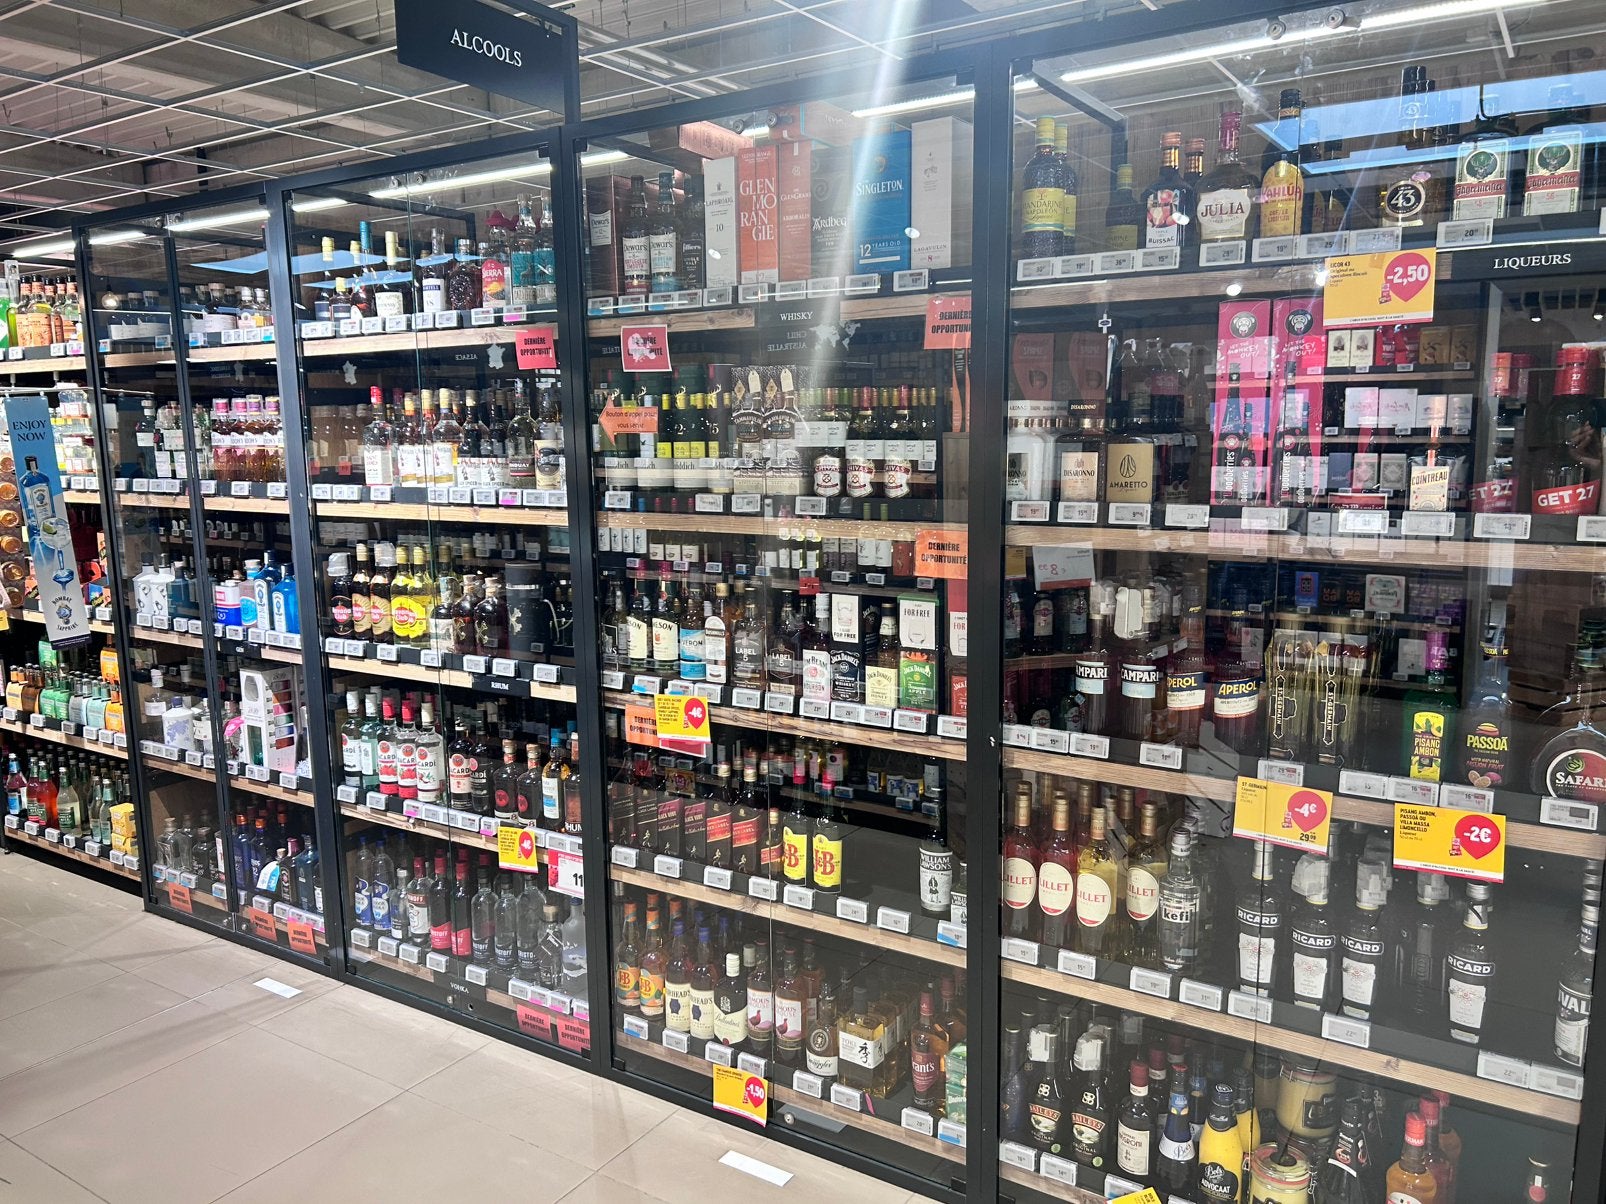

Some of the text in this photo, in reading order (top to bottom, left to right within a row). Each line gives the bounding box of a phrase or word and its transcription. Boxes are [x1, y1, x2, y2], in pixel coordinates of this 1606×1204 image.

[450, 28, 522, 69] ALCOOLS
[740, 178, 775, 195] GLEN
[753, 193, 777, 210] MO
[1391, 188, 1415, 208] 43
[1201, 201, 1244, 218] JULIA
[741, 210, 768, 227] RAN
[752, 225, 774, 241] GIE
[1148, 236, 1174, 246] BUISSAC
[859, 240, 901, 257] 12 YEARS OLD
[1494, 254, 1571, 269] LIQUEURS
[1387, 264, 1429, 285] -2,50
[780, 311, 814, 321] WHISKY
[931, 323, 971, 334] OPPORTUNI
[1227, 344, 1258, 354] MONKEY
[1282, 342, 1315, 352] MONKEY
[12, 419, 48, 431] ENJOY
[17, 431, 46, 442] NOW
[1064, 469, 1094, 477] DISARONNO
[1411, 470, 1448, 485] COINTREAU
[1110, 481, 1148, 489] AMARETTO
[1469, 481, 1512, 499] ET 27
[1537, 486, 1594, 506] GET 27
[928, 541, 960, 552] DERNIÈRE
[921, 553, 967, 564] OPPORTUNITÉ
[904, 608, 930, 617] FOR FREE
[736, 647, 757, 655] LABEL
[772, 653, 792, 661] LABEL
[1076, 667, 1108, 679] AMPARI
[1121, 669, 1159, 682] CAMPARI
[491, 681, 509, 691] RHUM
[1167, 677, 1197, 689] PEROL
[1219, 682, 1256, 697] APEROL
[688, 707, 703, 718] -4€
[634, 715, 656, 726] DERNIÈR
[630, 725, 657, 736] OPPORTUN
[1414, 738, 1440, 748] PISANG
[1414, 747, 1440, 757] AMBON
[1294, 803, 1317, 817] -4€
[1464, 826, 1491, 843] -2€
[921, 853, 949, 864] WILLIAM
[1126, 885, 1156, 896] ILLET
[1163, 908, 1190, 922] kefi
[1237, 909, 1278, 924] RICARD
[1292, 931, 1332, 947] RICARD
[1341, 936, 1380, 952] RICARD
[1448, 955, 1492, 975] RICARD
[1558, 991, 1591, 1015] UVAL
[562, 1033, 590, 1045] OPPORTUNIT
[911, 1060, 935, 1073] rant's
[747, 1084, 765, 1099] -1,50
[1030, 1105, 1058, 1118] AILEYS
[1073, 1114, 1102, 1129] AILEYS
[1202, 1178, 1231, 1194] ADVOCAAT
